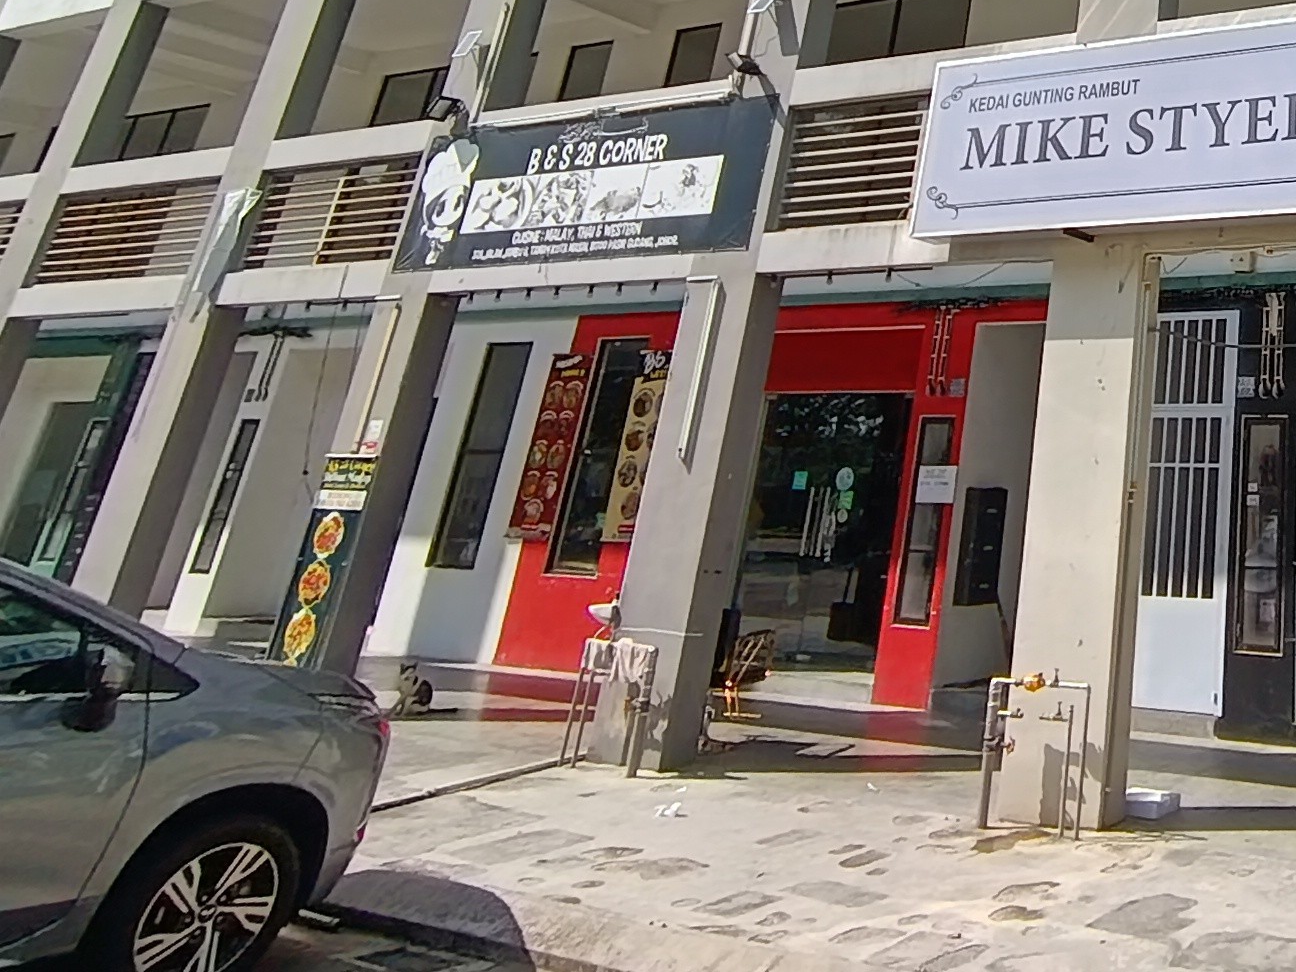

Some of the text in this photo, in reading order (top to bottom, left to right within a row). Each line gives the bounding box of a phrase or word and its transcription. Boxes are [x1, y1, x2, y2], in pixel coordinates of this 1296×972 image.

[969, 79, 1140, 113] KEDAI GUNTING RAMBUT
[527, 134, 668, 176] B & S 28 CORNER
[960, 113, 1109, 170] MIKE
